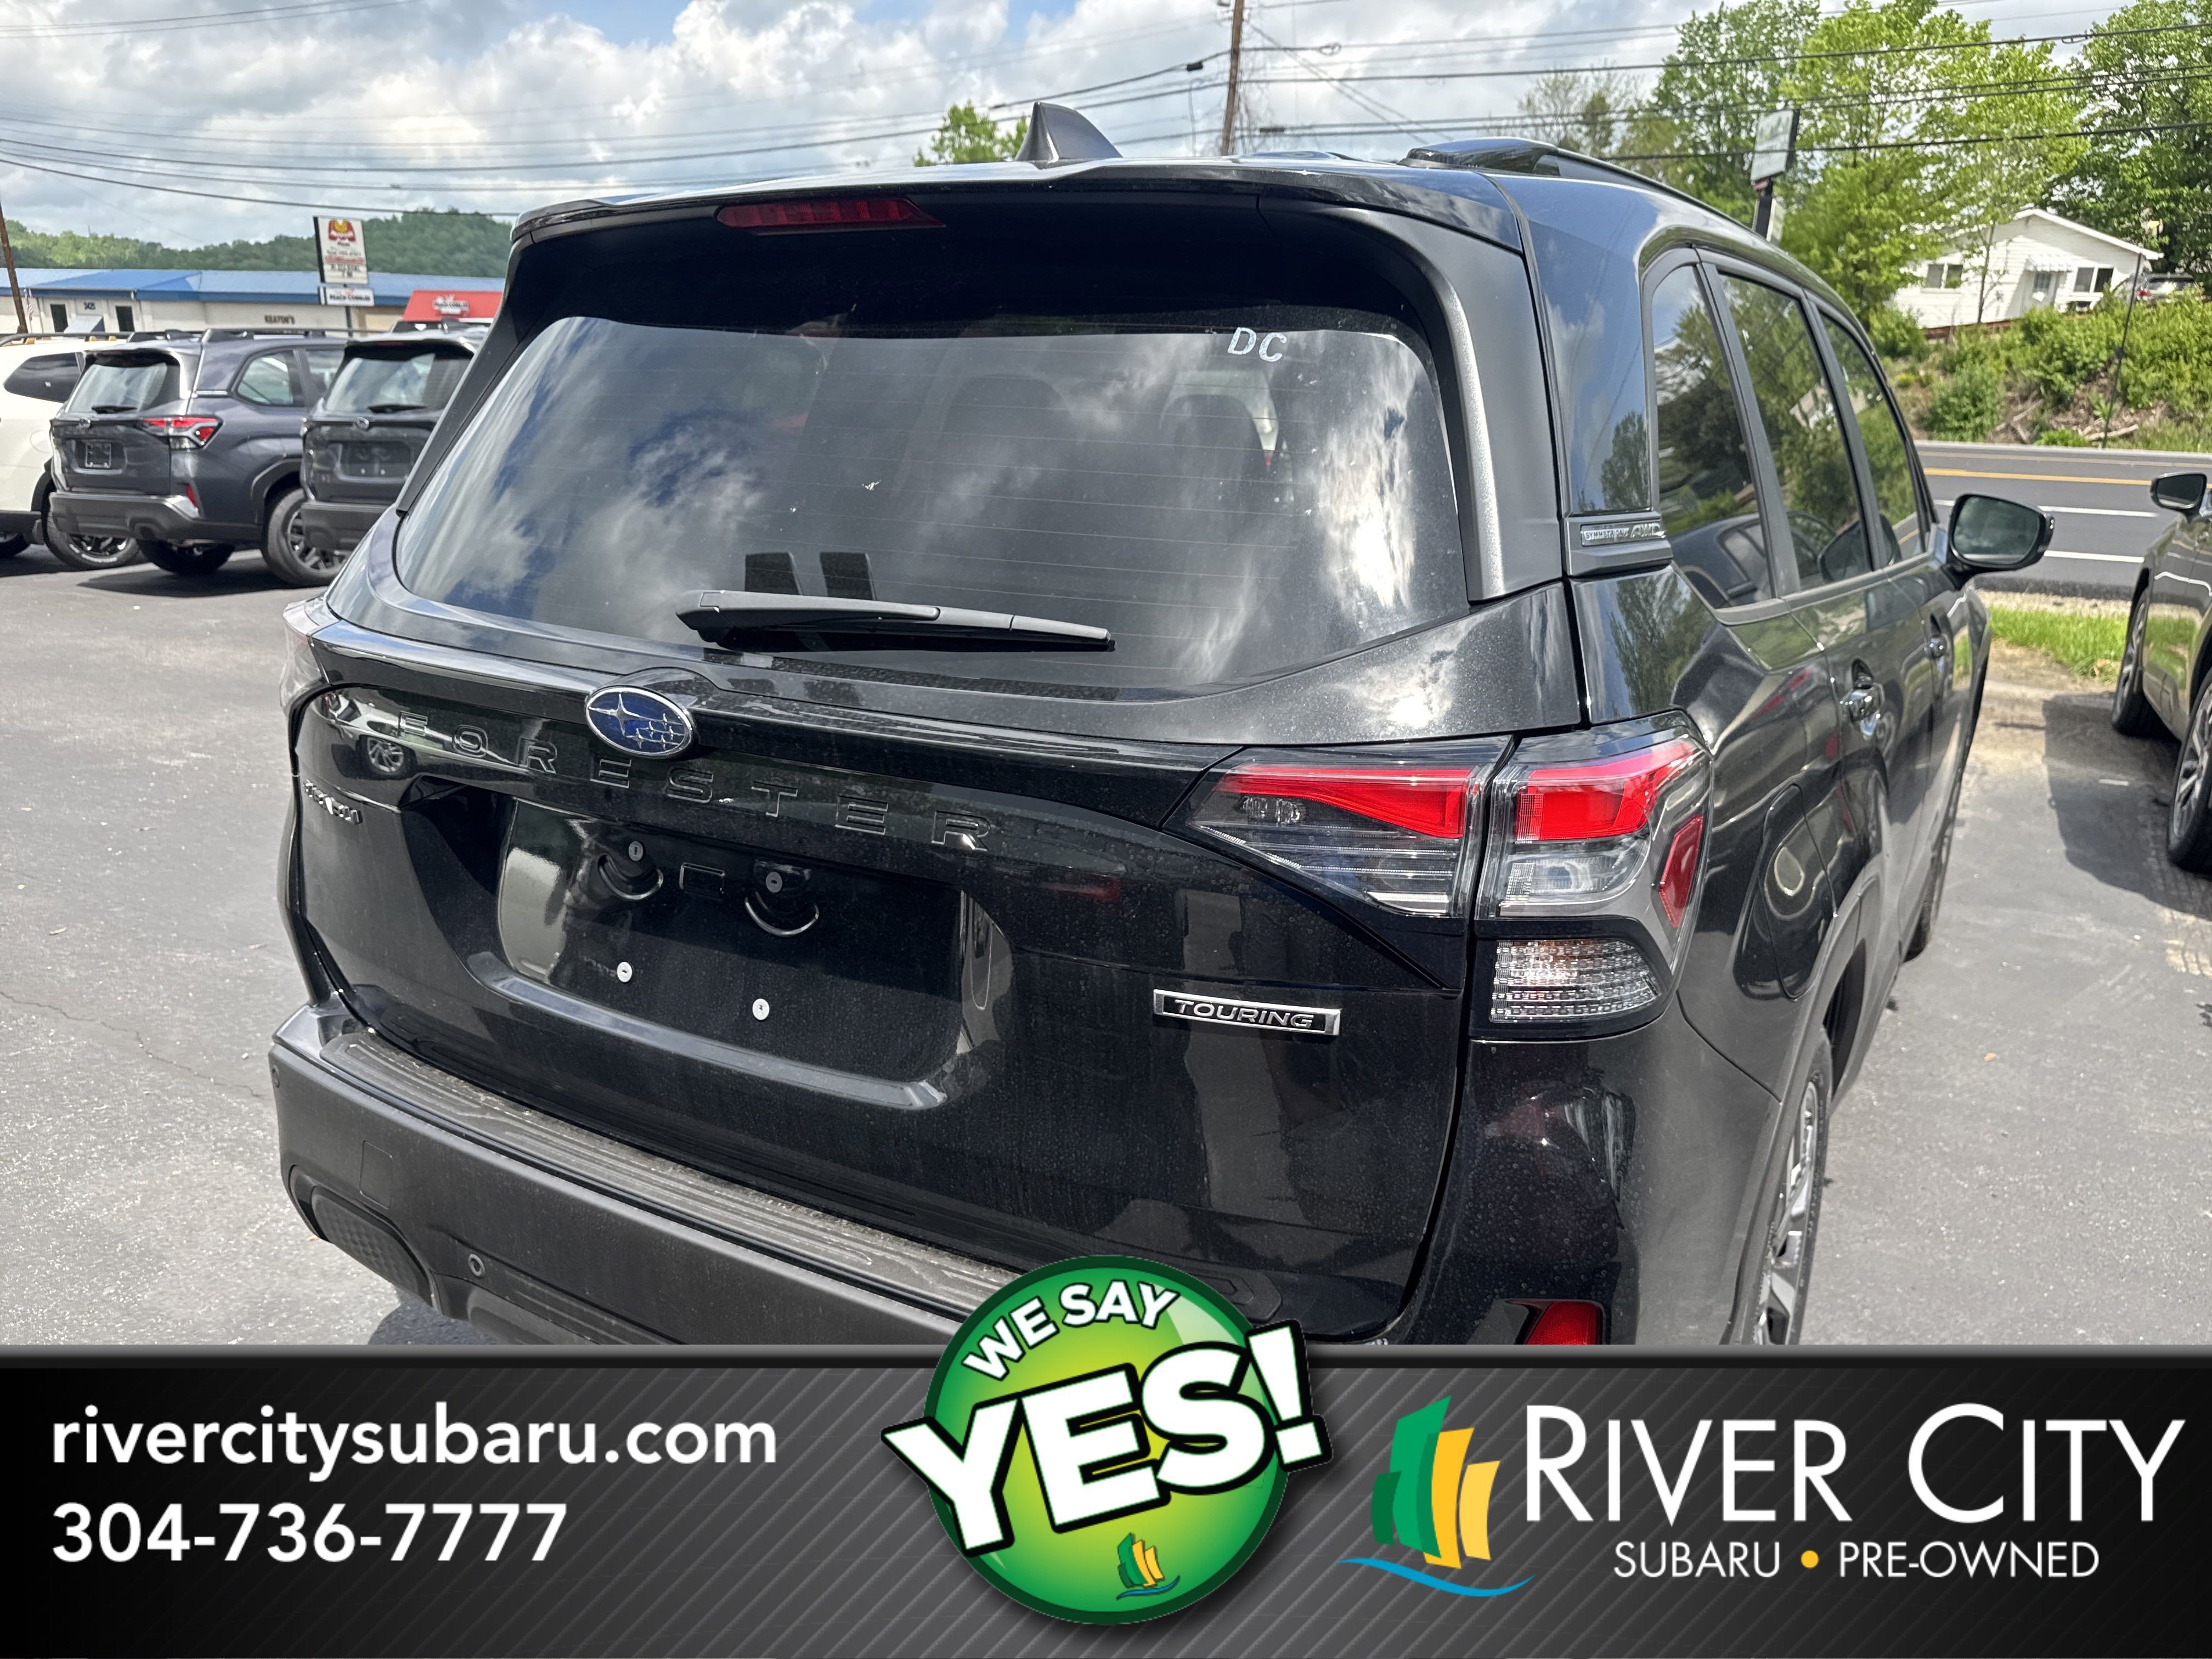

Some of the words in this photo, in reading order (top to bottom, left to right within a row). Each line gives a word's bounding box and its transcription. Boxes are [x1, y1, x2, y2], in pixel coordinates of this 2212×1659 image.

[1584, 528, 1628, 540] SYMMETRICAL
[1630, 522, 1664, 538] AWD
[397, 711, 990, 851] FORESTER
[1175, 998, 1314, 1029] TOURING
